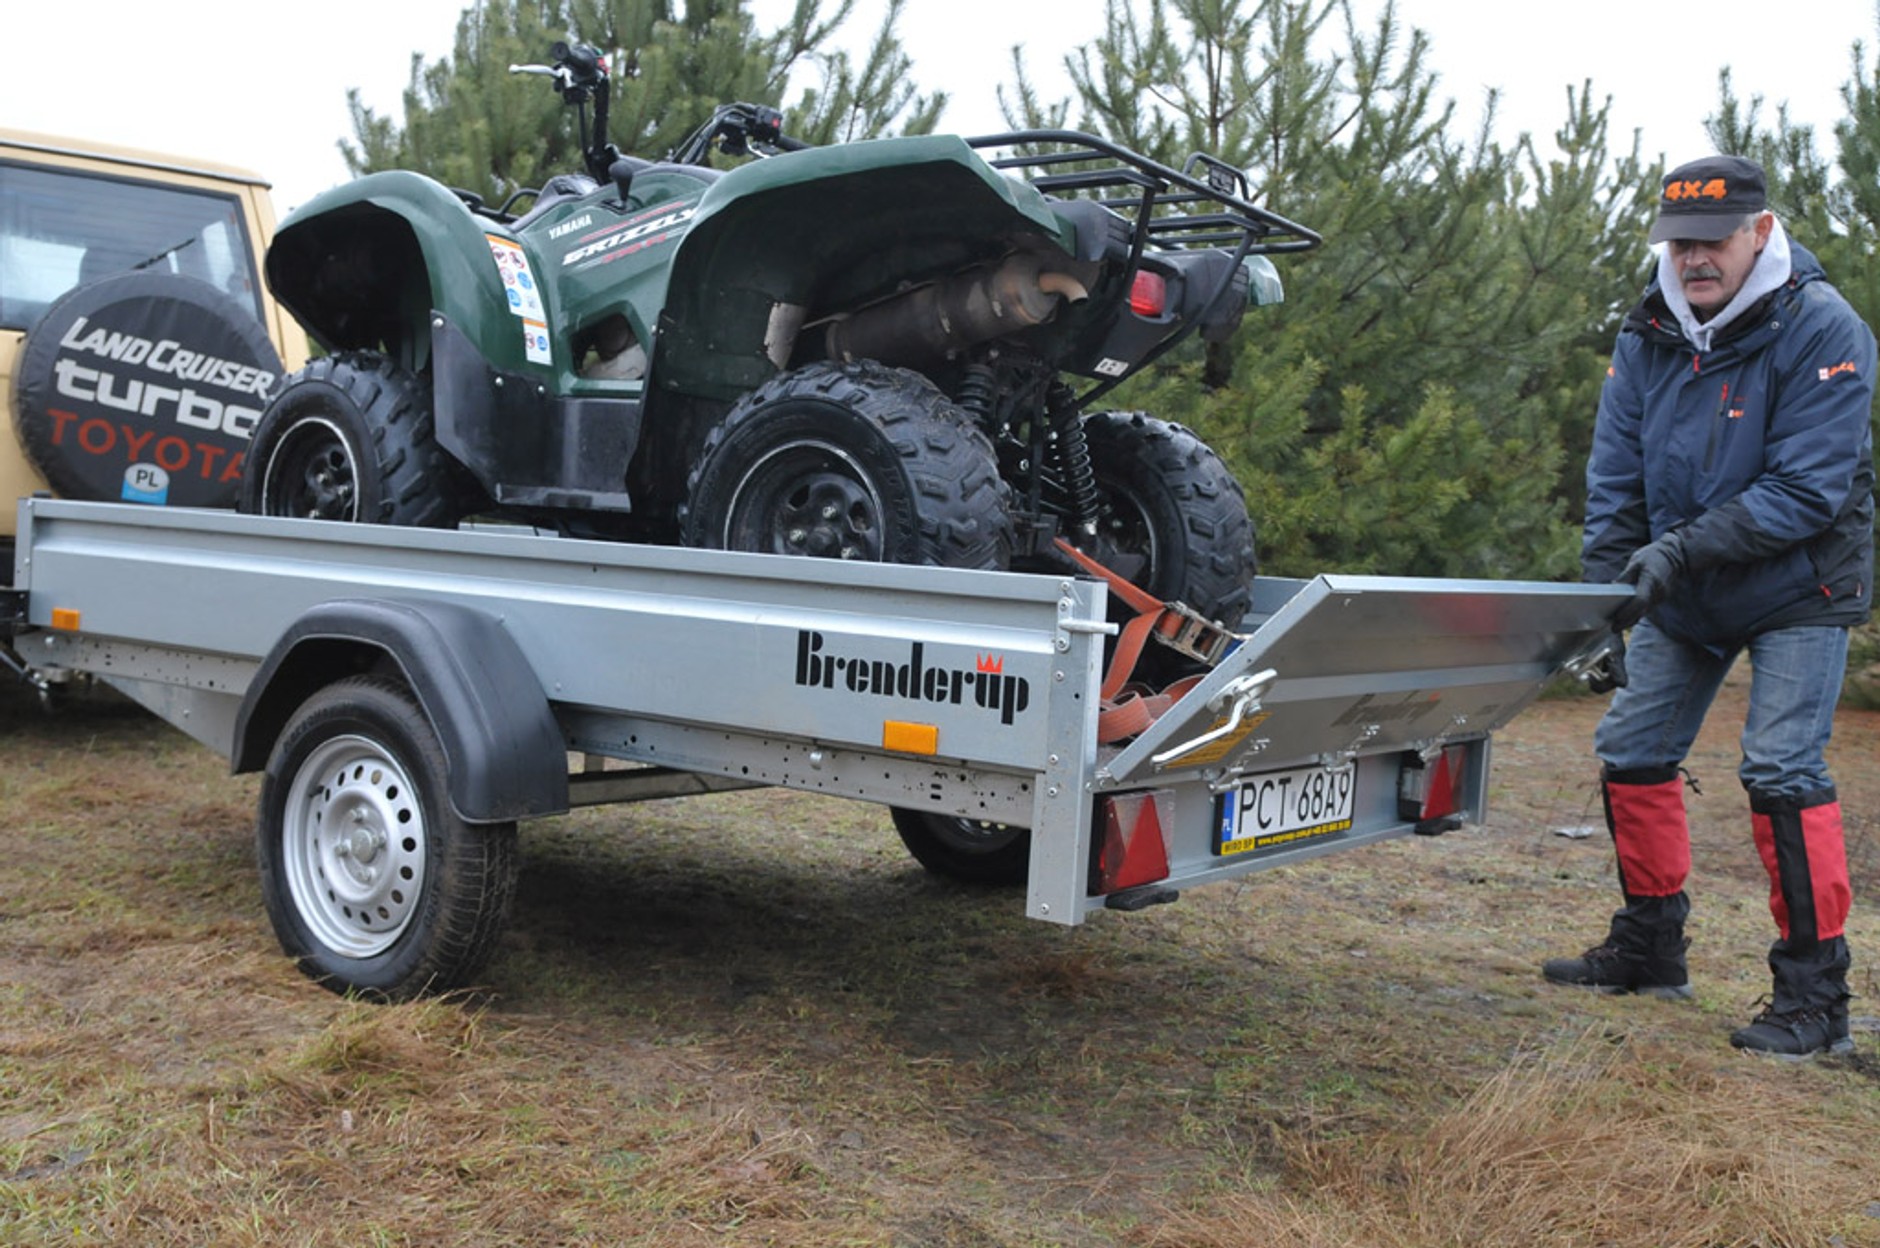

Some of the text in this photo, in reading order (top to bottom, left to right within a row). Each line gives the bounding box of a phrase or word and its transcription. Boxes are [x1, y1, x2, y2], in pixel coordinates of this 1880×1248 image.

[549, 214, 592, 240] YAMAHA
[60, 317, 275, 400] LAND CRUISER
[135, 469, 159, 489] PL
[795, 629, 1030, 726] Brenderup
[1237, 776, 1292, 835] PCT
[1298, 771, 1350, 823] 68A9
